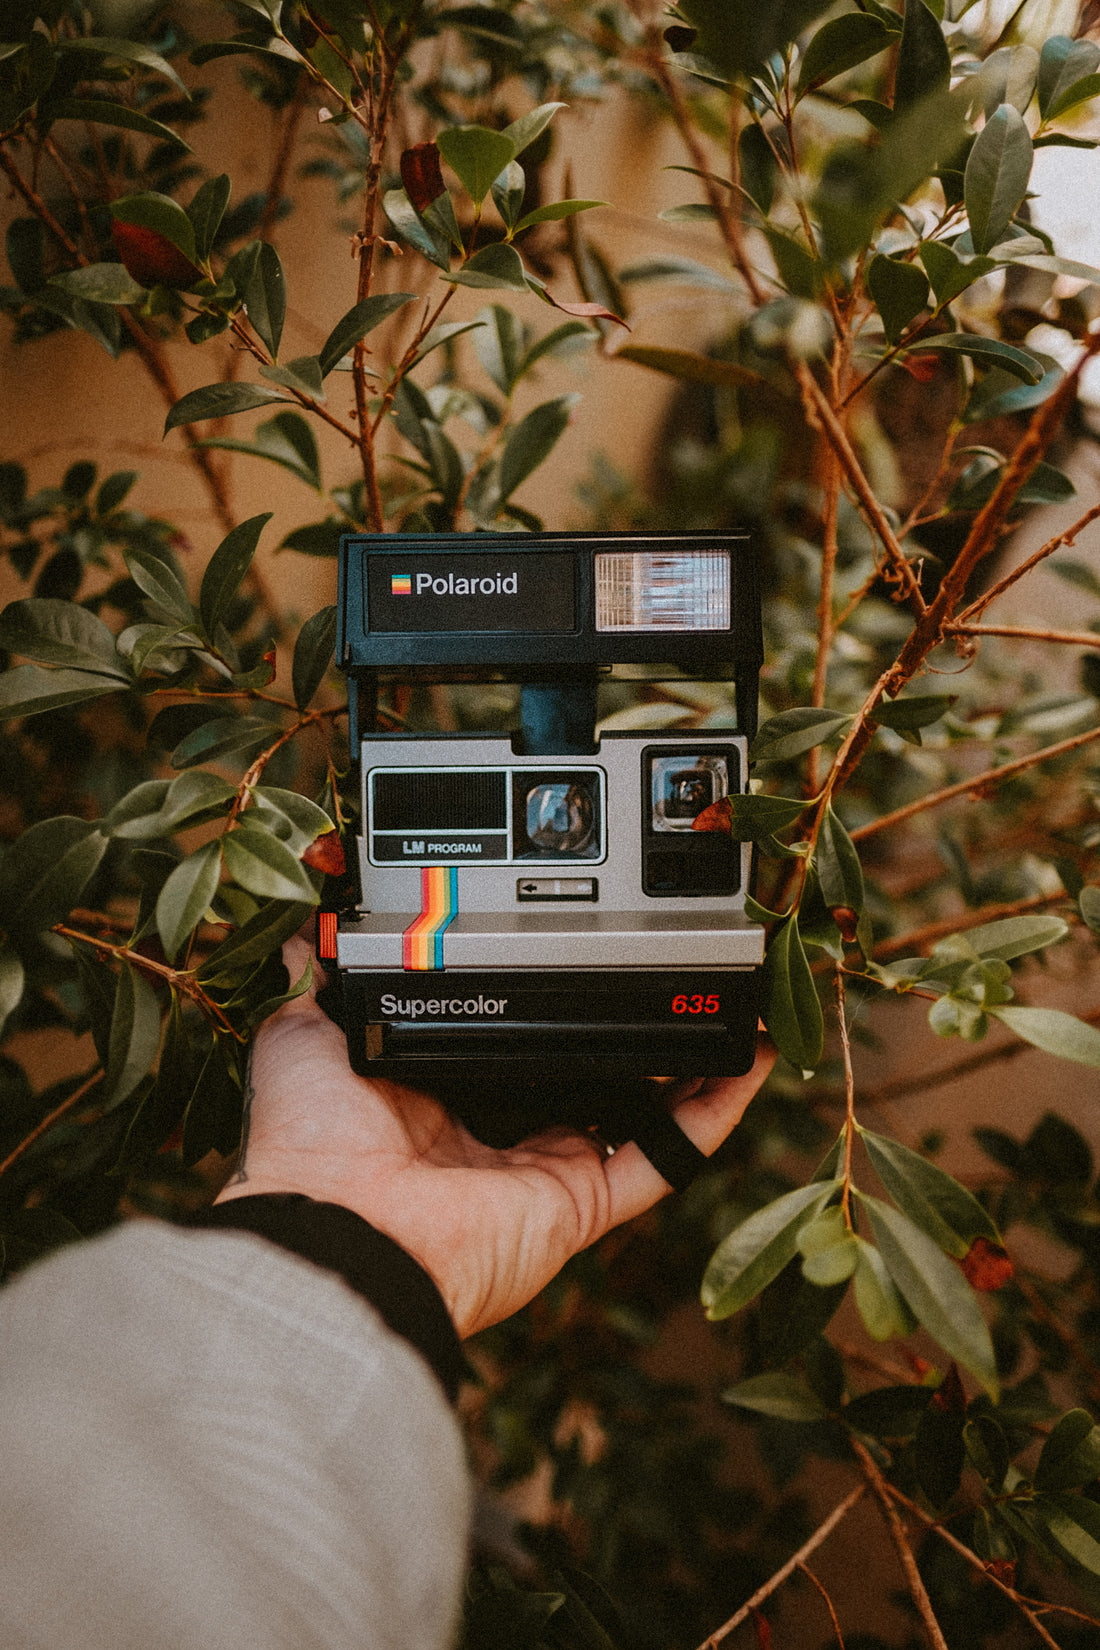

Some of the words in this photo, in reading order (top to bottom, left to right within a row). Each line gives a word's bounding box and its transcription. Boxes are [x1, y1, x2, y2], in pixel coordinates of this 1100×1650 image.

[415, 572, 518, 596] Polaroid
[402, 840, 425, 855] LM
[427, 842, 482, 854] PROGRAM
[380, 994, 508, 1018] Supercolor
[671, 995, 721, 1014] 635
